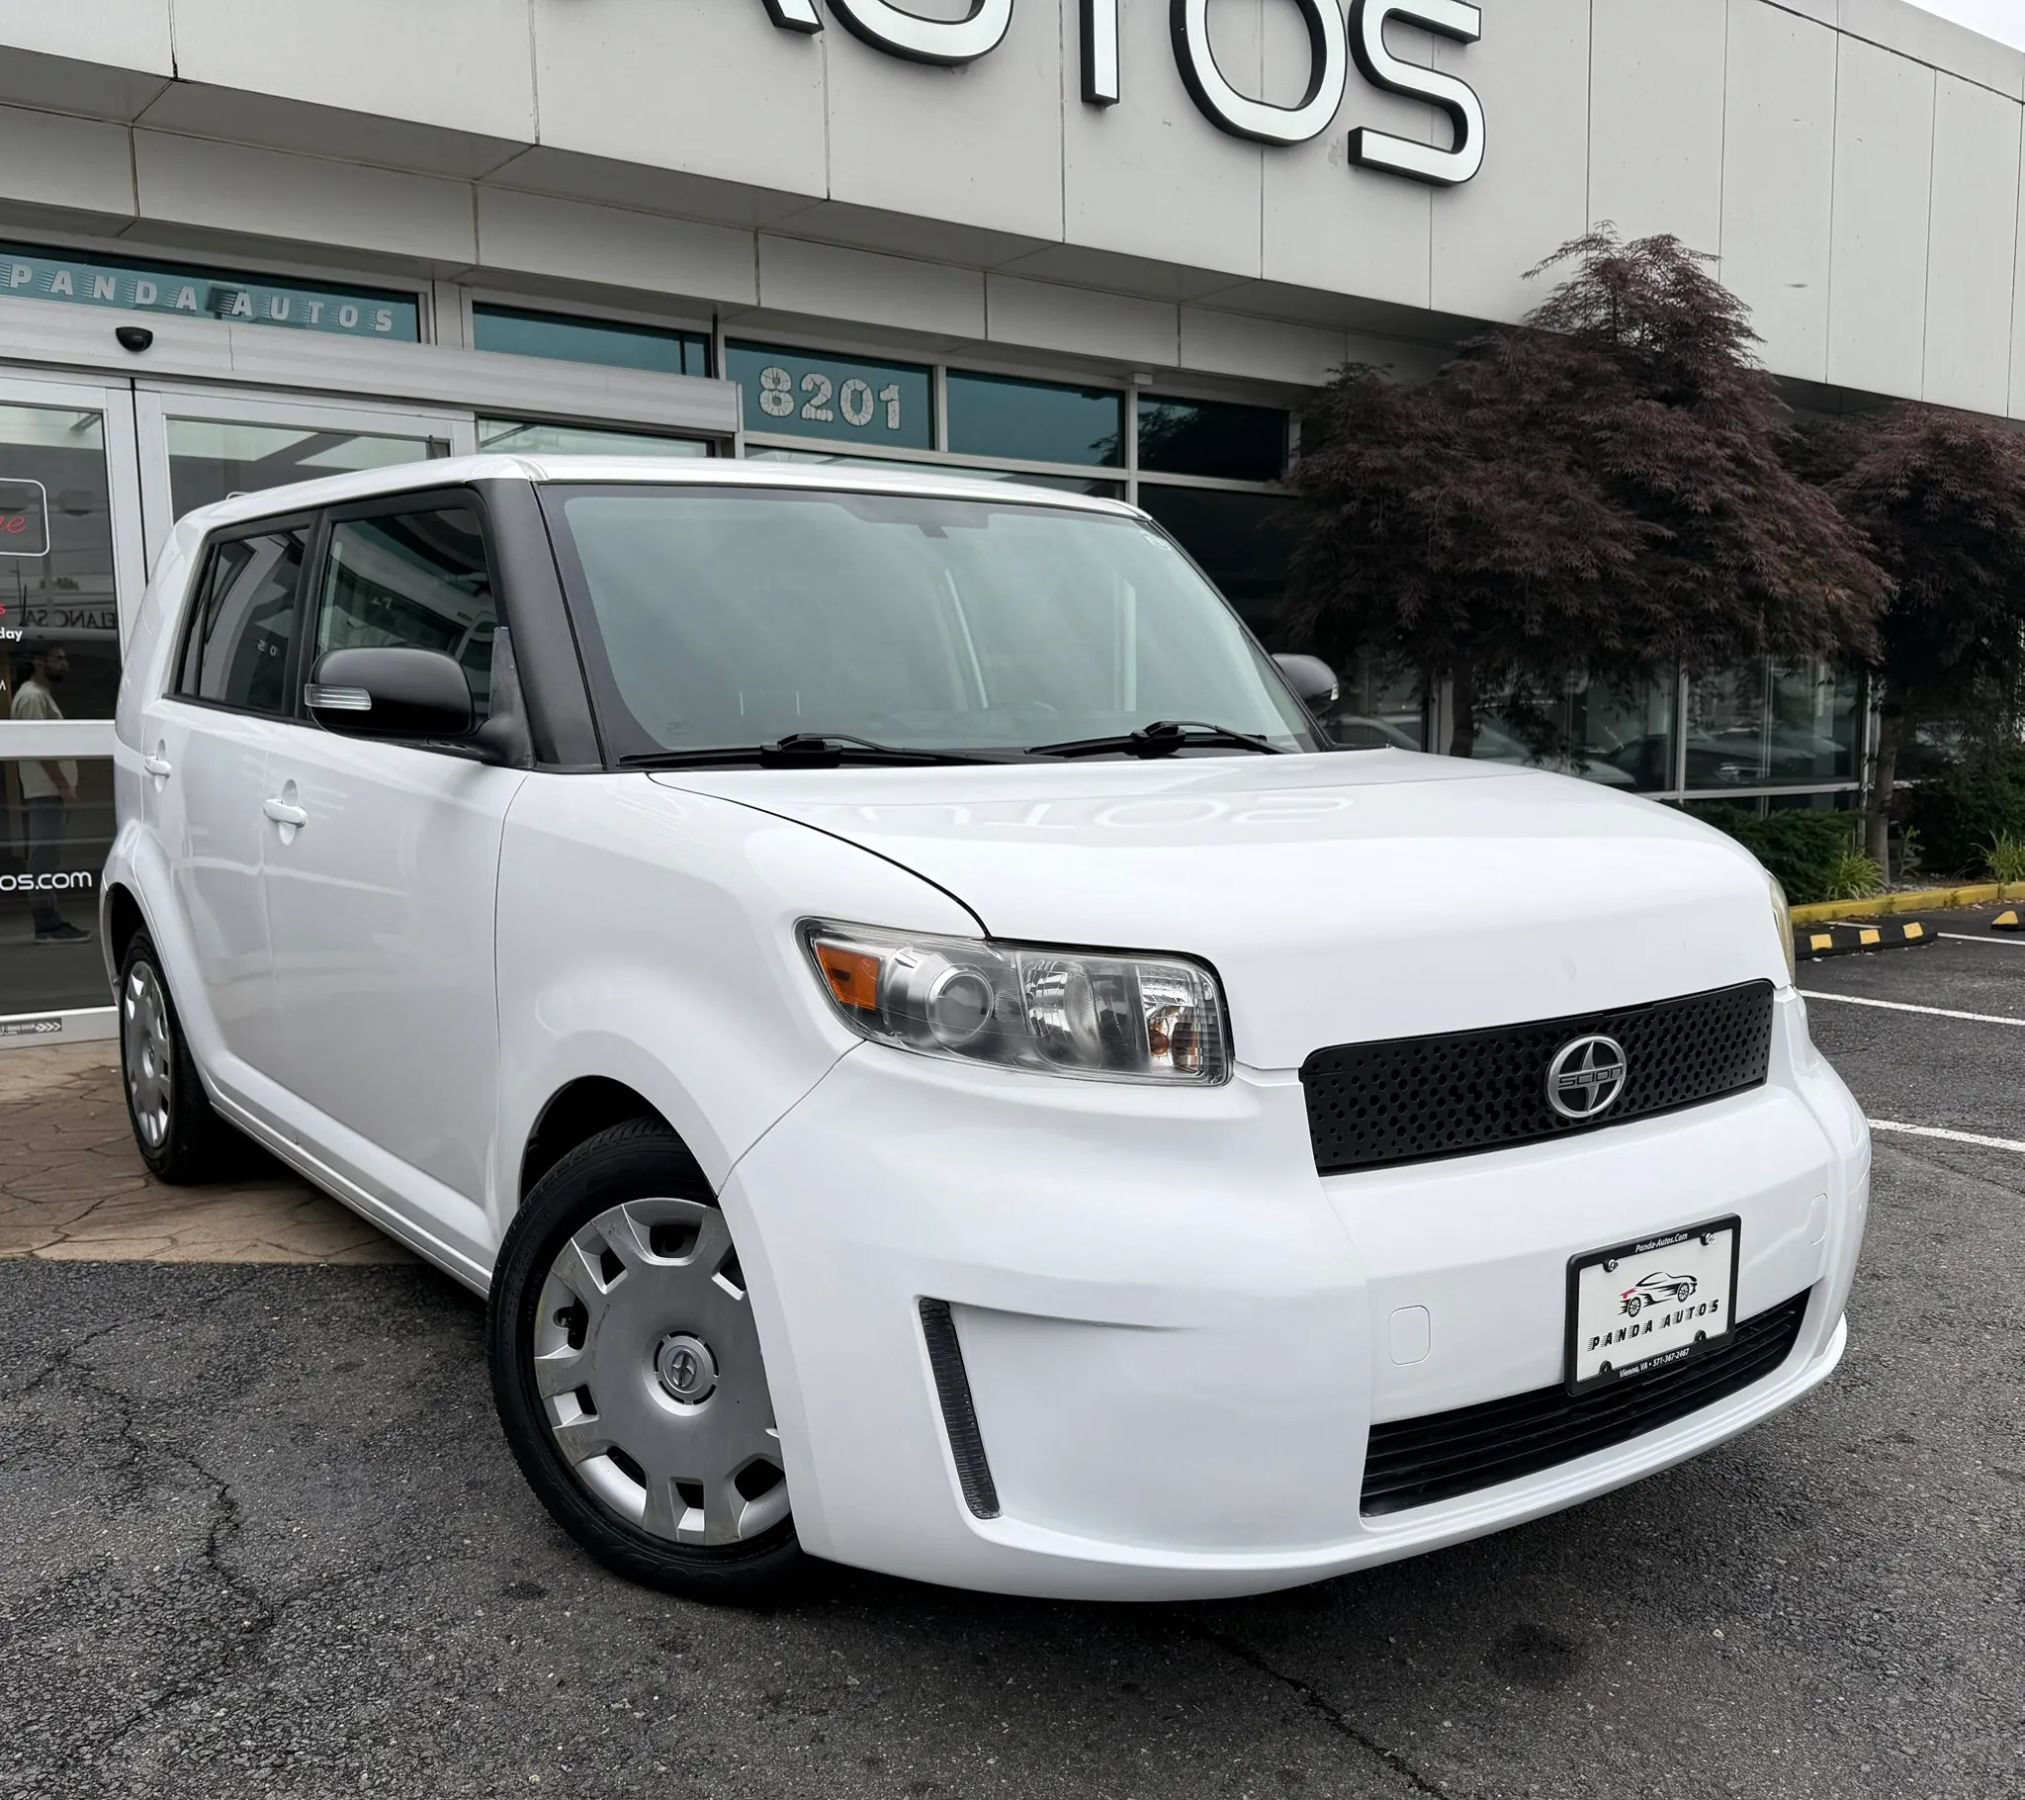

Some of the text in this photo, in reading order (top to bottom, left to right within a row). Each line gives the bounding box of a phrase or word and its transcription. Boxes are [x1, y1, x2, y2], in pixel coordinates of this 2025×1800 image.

[6, 263, 393, 332] PANDA AUTOS
[759, 367, 900, 430] 8201
[1589, 1299, 1720, 1351] PANDA AUTOS
